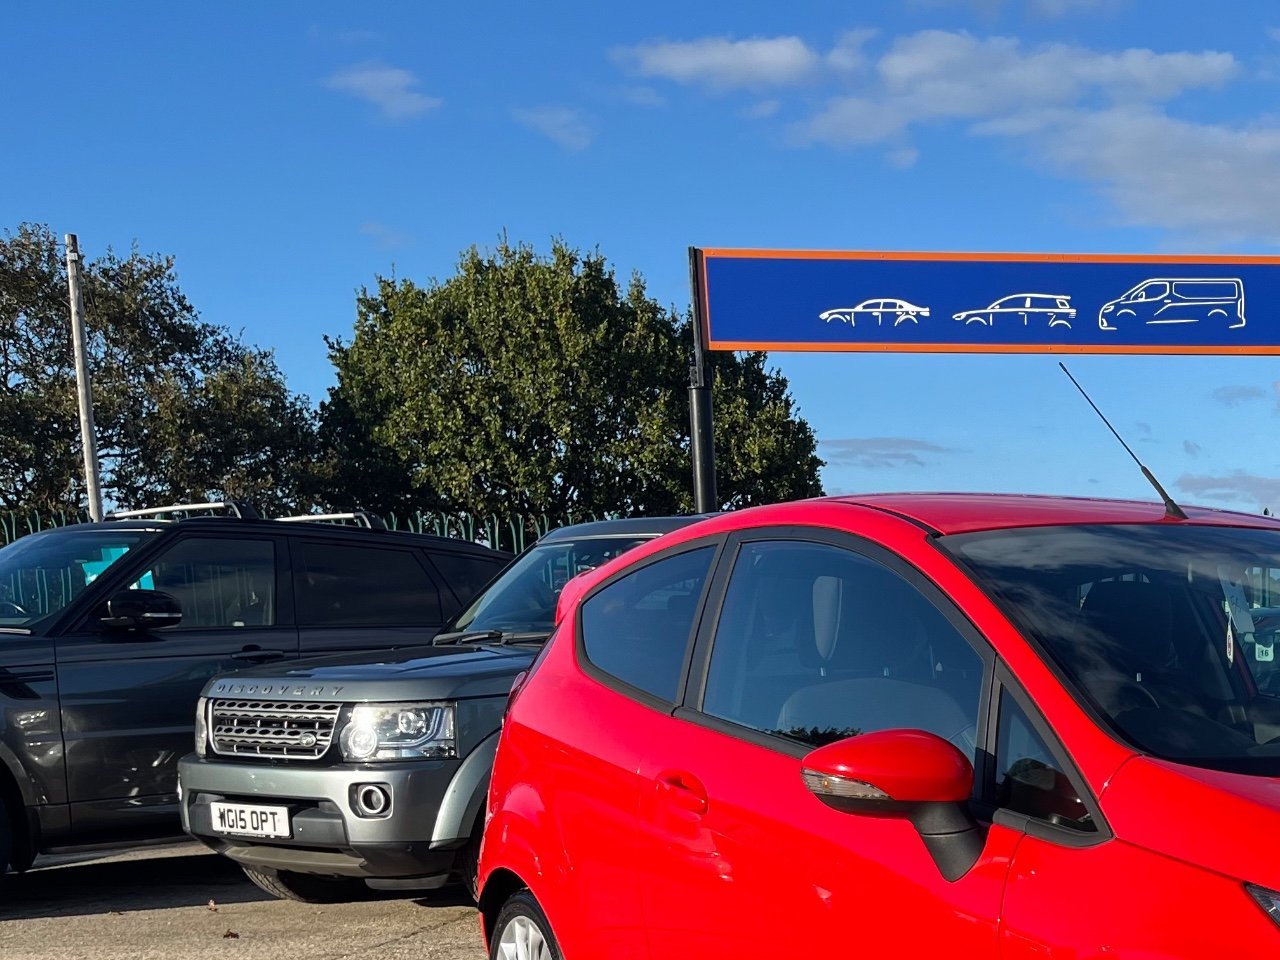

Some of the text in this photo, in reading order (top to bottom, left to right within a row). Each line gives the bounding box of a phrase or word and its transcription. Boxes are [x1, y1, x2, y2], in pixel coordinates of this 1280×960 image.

[216, 684, 344, 696] DISCOVERY
[218, 807, 278, 832] WG15 OPT
